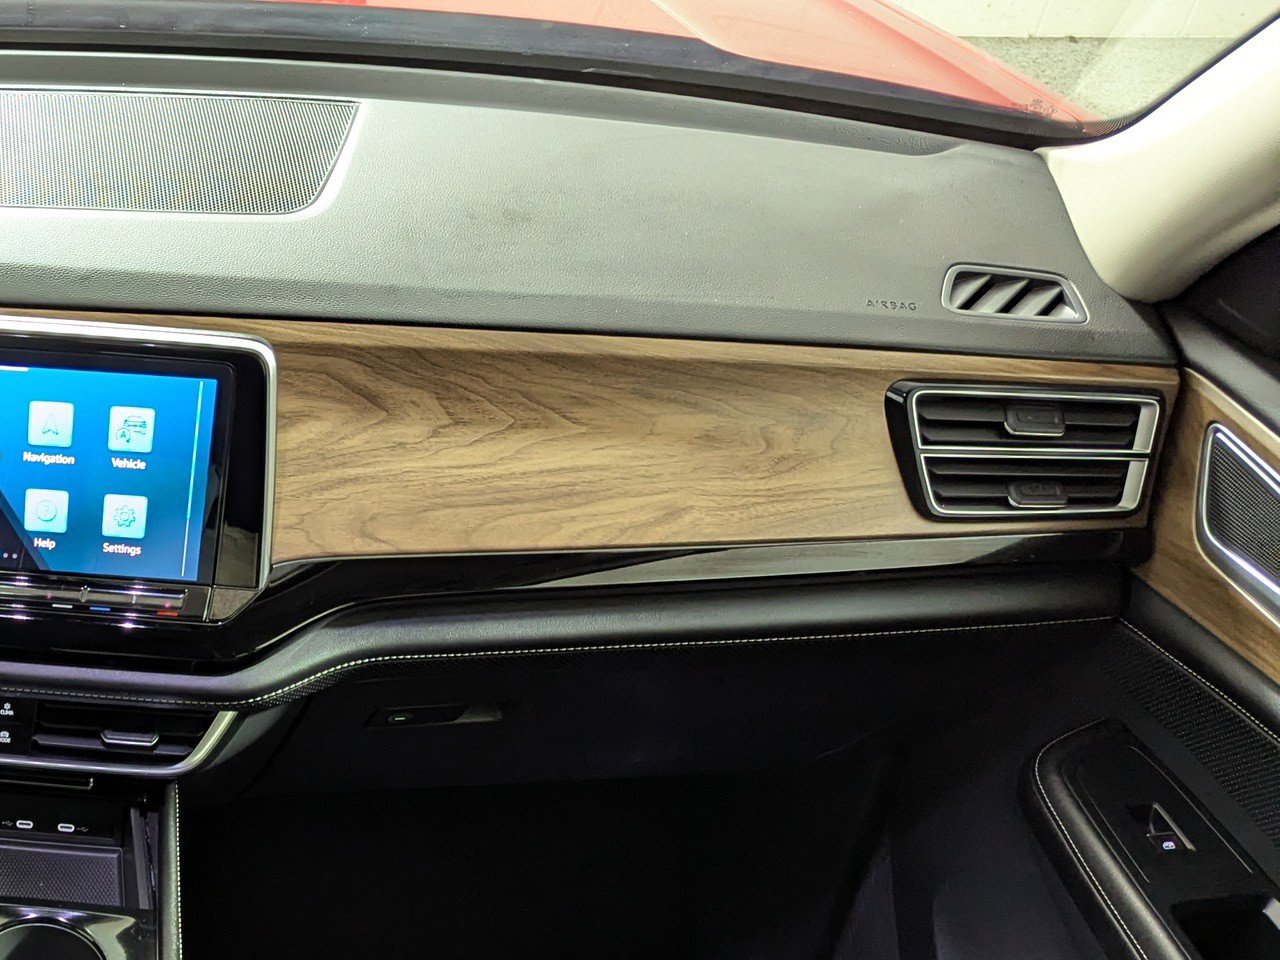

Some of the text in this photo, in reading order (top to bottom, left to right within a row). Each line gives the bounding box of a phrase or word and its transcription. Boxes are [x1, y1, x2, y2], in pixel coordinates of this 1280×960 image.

[865, 299, 917, 311] AIRBAG
[22, 451, 76, 466] Navigation
[111, 456, 147, 470] Vehicle
[33, 536, 56, 550] Help
[102, 541, 142, 557] Settings
